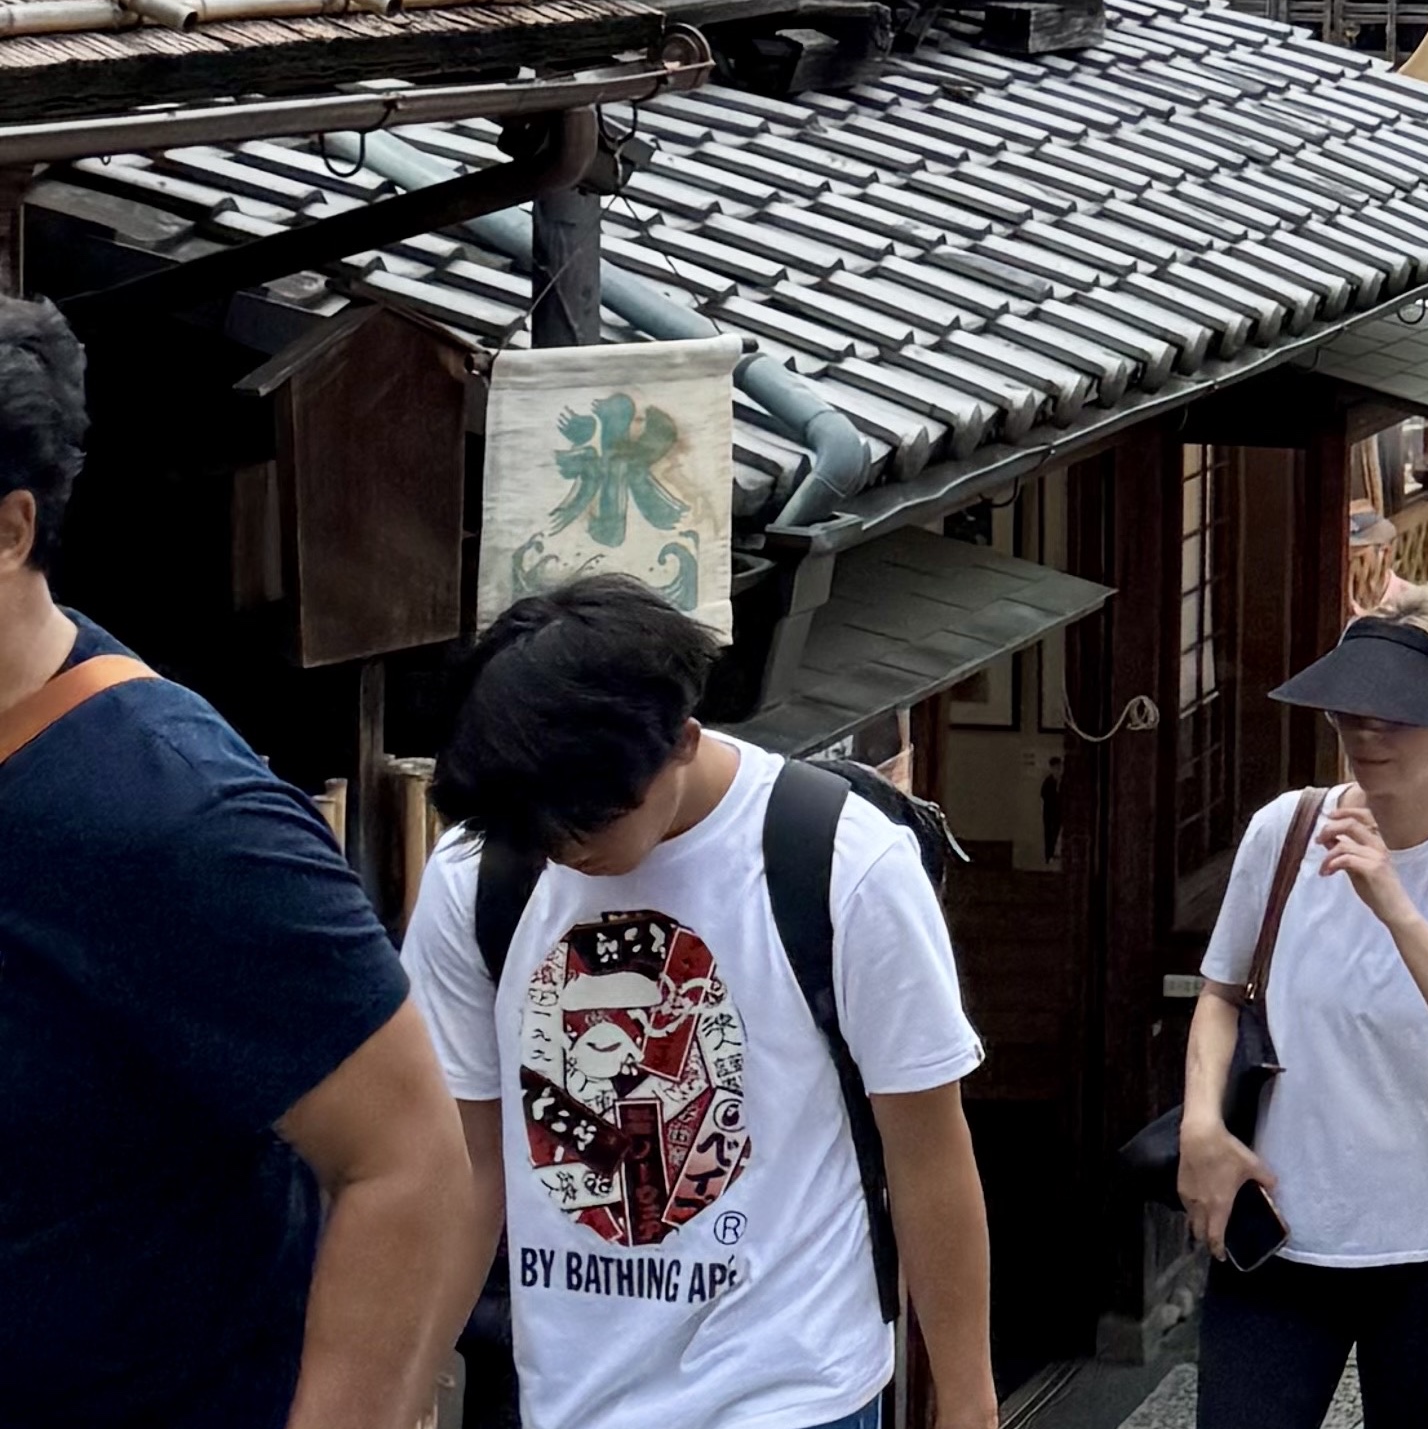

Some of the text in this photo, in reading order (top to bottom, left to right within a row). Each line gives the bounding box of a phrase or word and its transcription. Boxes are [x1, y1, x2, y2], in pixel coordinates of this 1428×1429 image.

[549, 392, 692, 548] 氷
[520, 1247, 555, 1288] BY
[566, 1251, 682, 1303] BATHING
